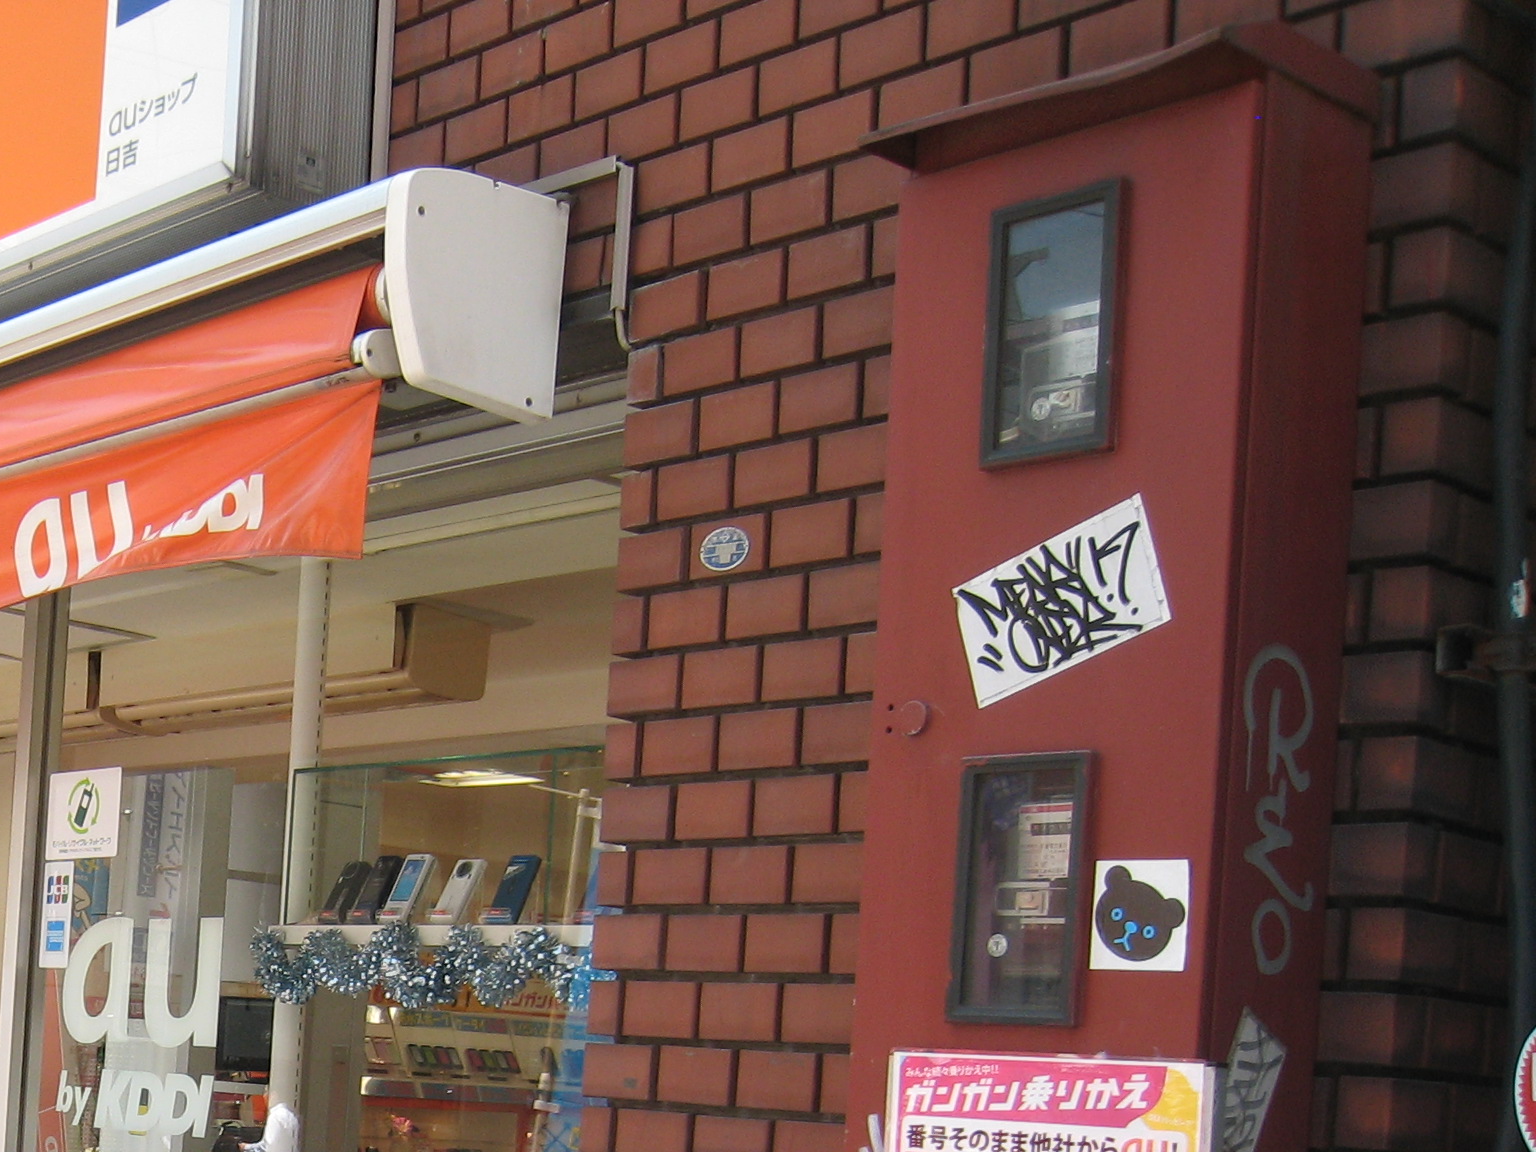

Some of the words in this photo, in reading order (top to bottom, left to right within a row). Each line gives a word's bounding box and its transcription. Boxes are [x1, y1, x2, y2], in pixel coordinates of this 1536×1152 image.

[109, 72, 199, 137] auショップ
[105, 140, 140, 177] 日吉
[63, 916, 225, 1047] au
[55, 1070, 92, 1126] by
[93, 1068, 214, 1139] KDDI
[905, 1074, 1150, 1113] ガンガン乗りかえ
